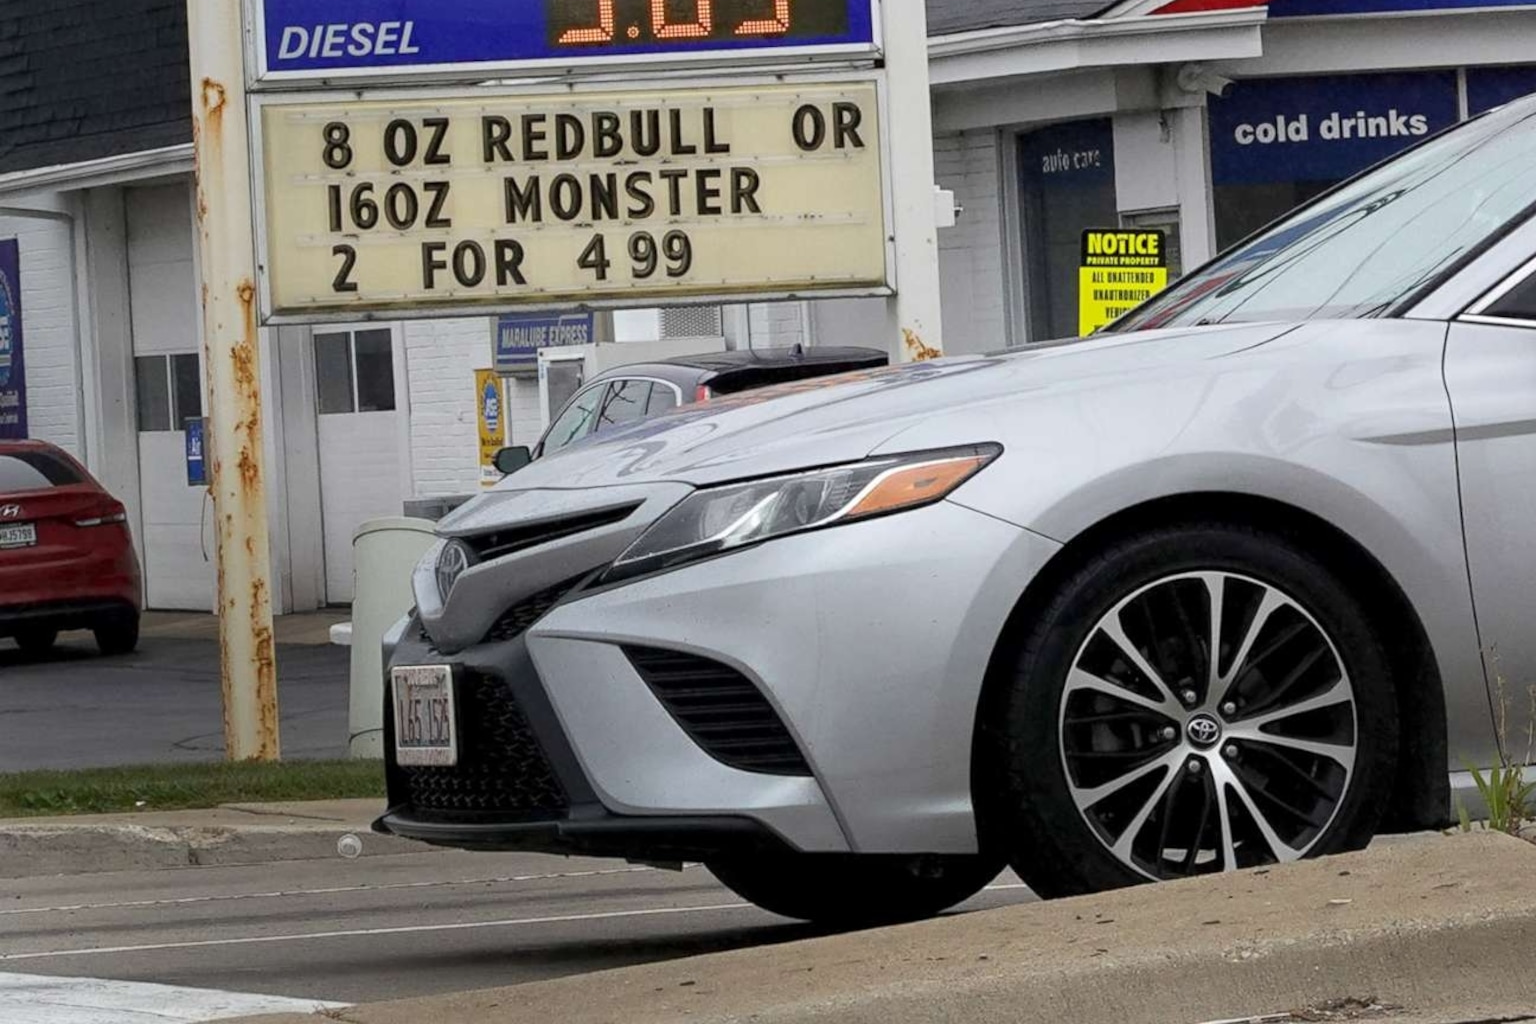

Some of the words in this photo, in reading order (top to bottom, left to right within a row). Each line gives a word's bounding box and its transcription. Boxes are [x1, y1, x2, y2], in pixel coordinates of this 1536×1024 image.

[277, 21, 420, 60] DIESEL
[322, 121, 353, 170] 8
[384, 116, 451, 167] OZ
[482, 108, 731, 163] REDBULL
[791, 101, 865, 152] OR
[1234, 113, 1308, 146] cold
[1319, 108, 1429, 141] drinks
[1042, 148, 1070, 174] auto
[1073, 149, 1101, 170] care
[504, 166, 762, 224] MONSTER
[1087, 232, 1159, 256] NOTICE
[331, 243, 357, 293] 2
[421, 239, 527, 290] FOR
[1086, 256, 1119, 266] PRIVATE
[1120, 256, 1160, 266] PROPERTY
[1092, 272, 1105, 284] ALL
[1107, 271, 1155, 284] UNATTENDED
[1106, 307, 1130, 319] VEHI
[501, 324, 547, 349] MARALUBE
[548, 323, 589, 347] EXPRESS
